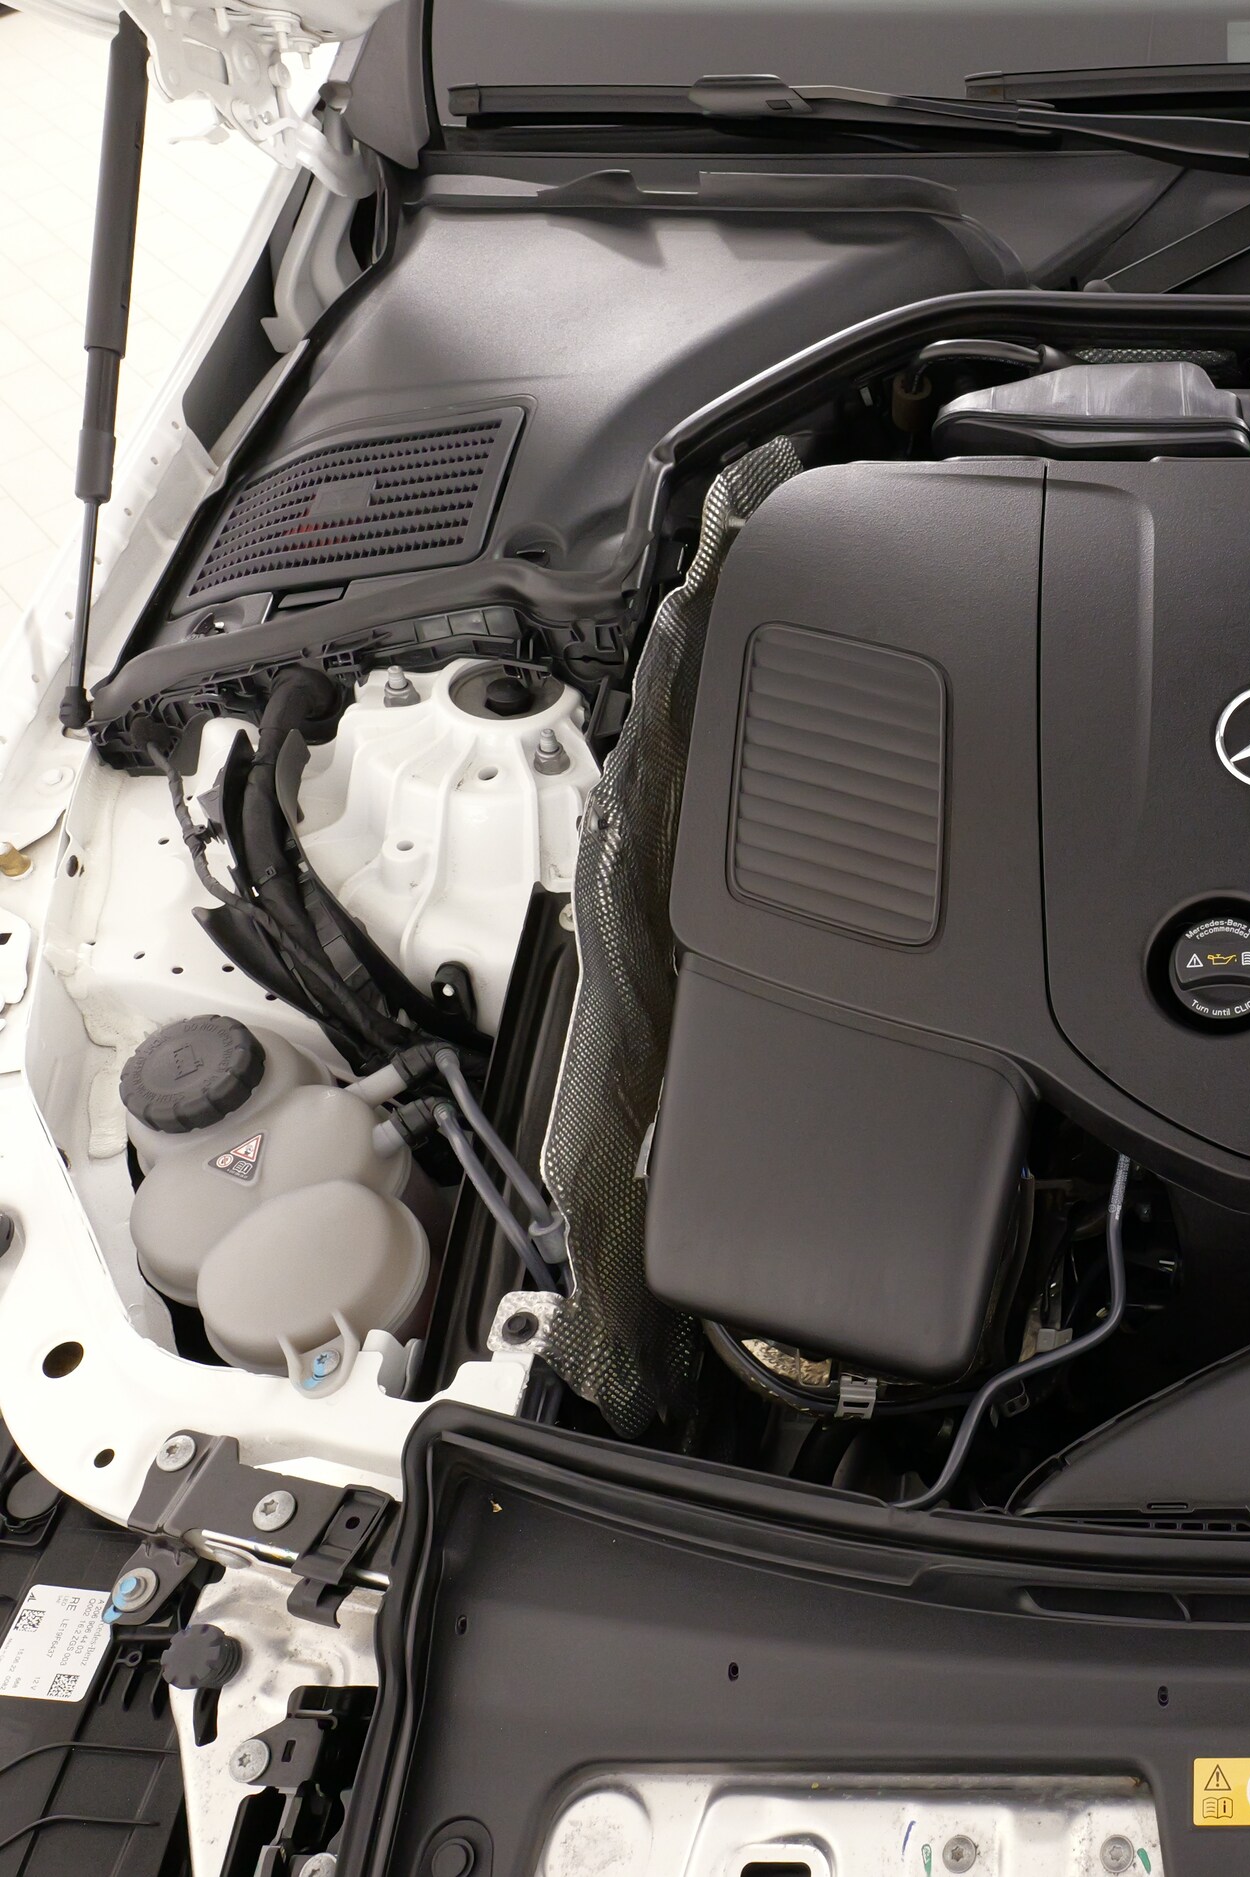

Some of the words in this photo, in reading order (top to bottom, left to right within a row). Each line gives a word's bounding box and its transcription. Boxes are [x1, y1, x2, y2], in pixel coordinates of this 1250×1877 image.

[1185, 919, 1247, 940] Mercedes-Benz
[1196, 927, 1250, 940] recommended
[1191, 999, 1209, 1013] Turn
[1212, 1008, 1230, 1016] until
[66, 1597, 80, 1611] RE
[91, 1606, 101, 1618] 206
[85, 1620, 95, 1633] 906
[67, 1635, 79, 1651] ZGS
[80, 1635, 88, 1643] 44
[74, 1645, 83, 1654] 03
[60, 1652, 70, 1665] 003
